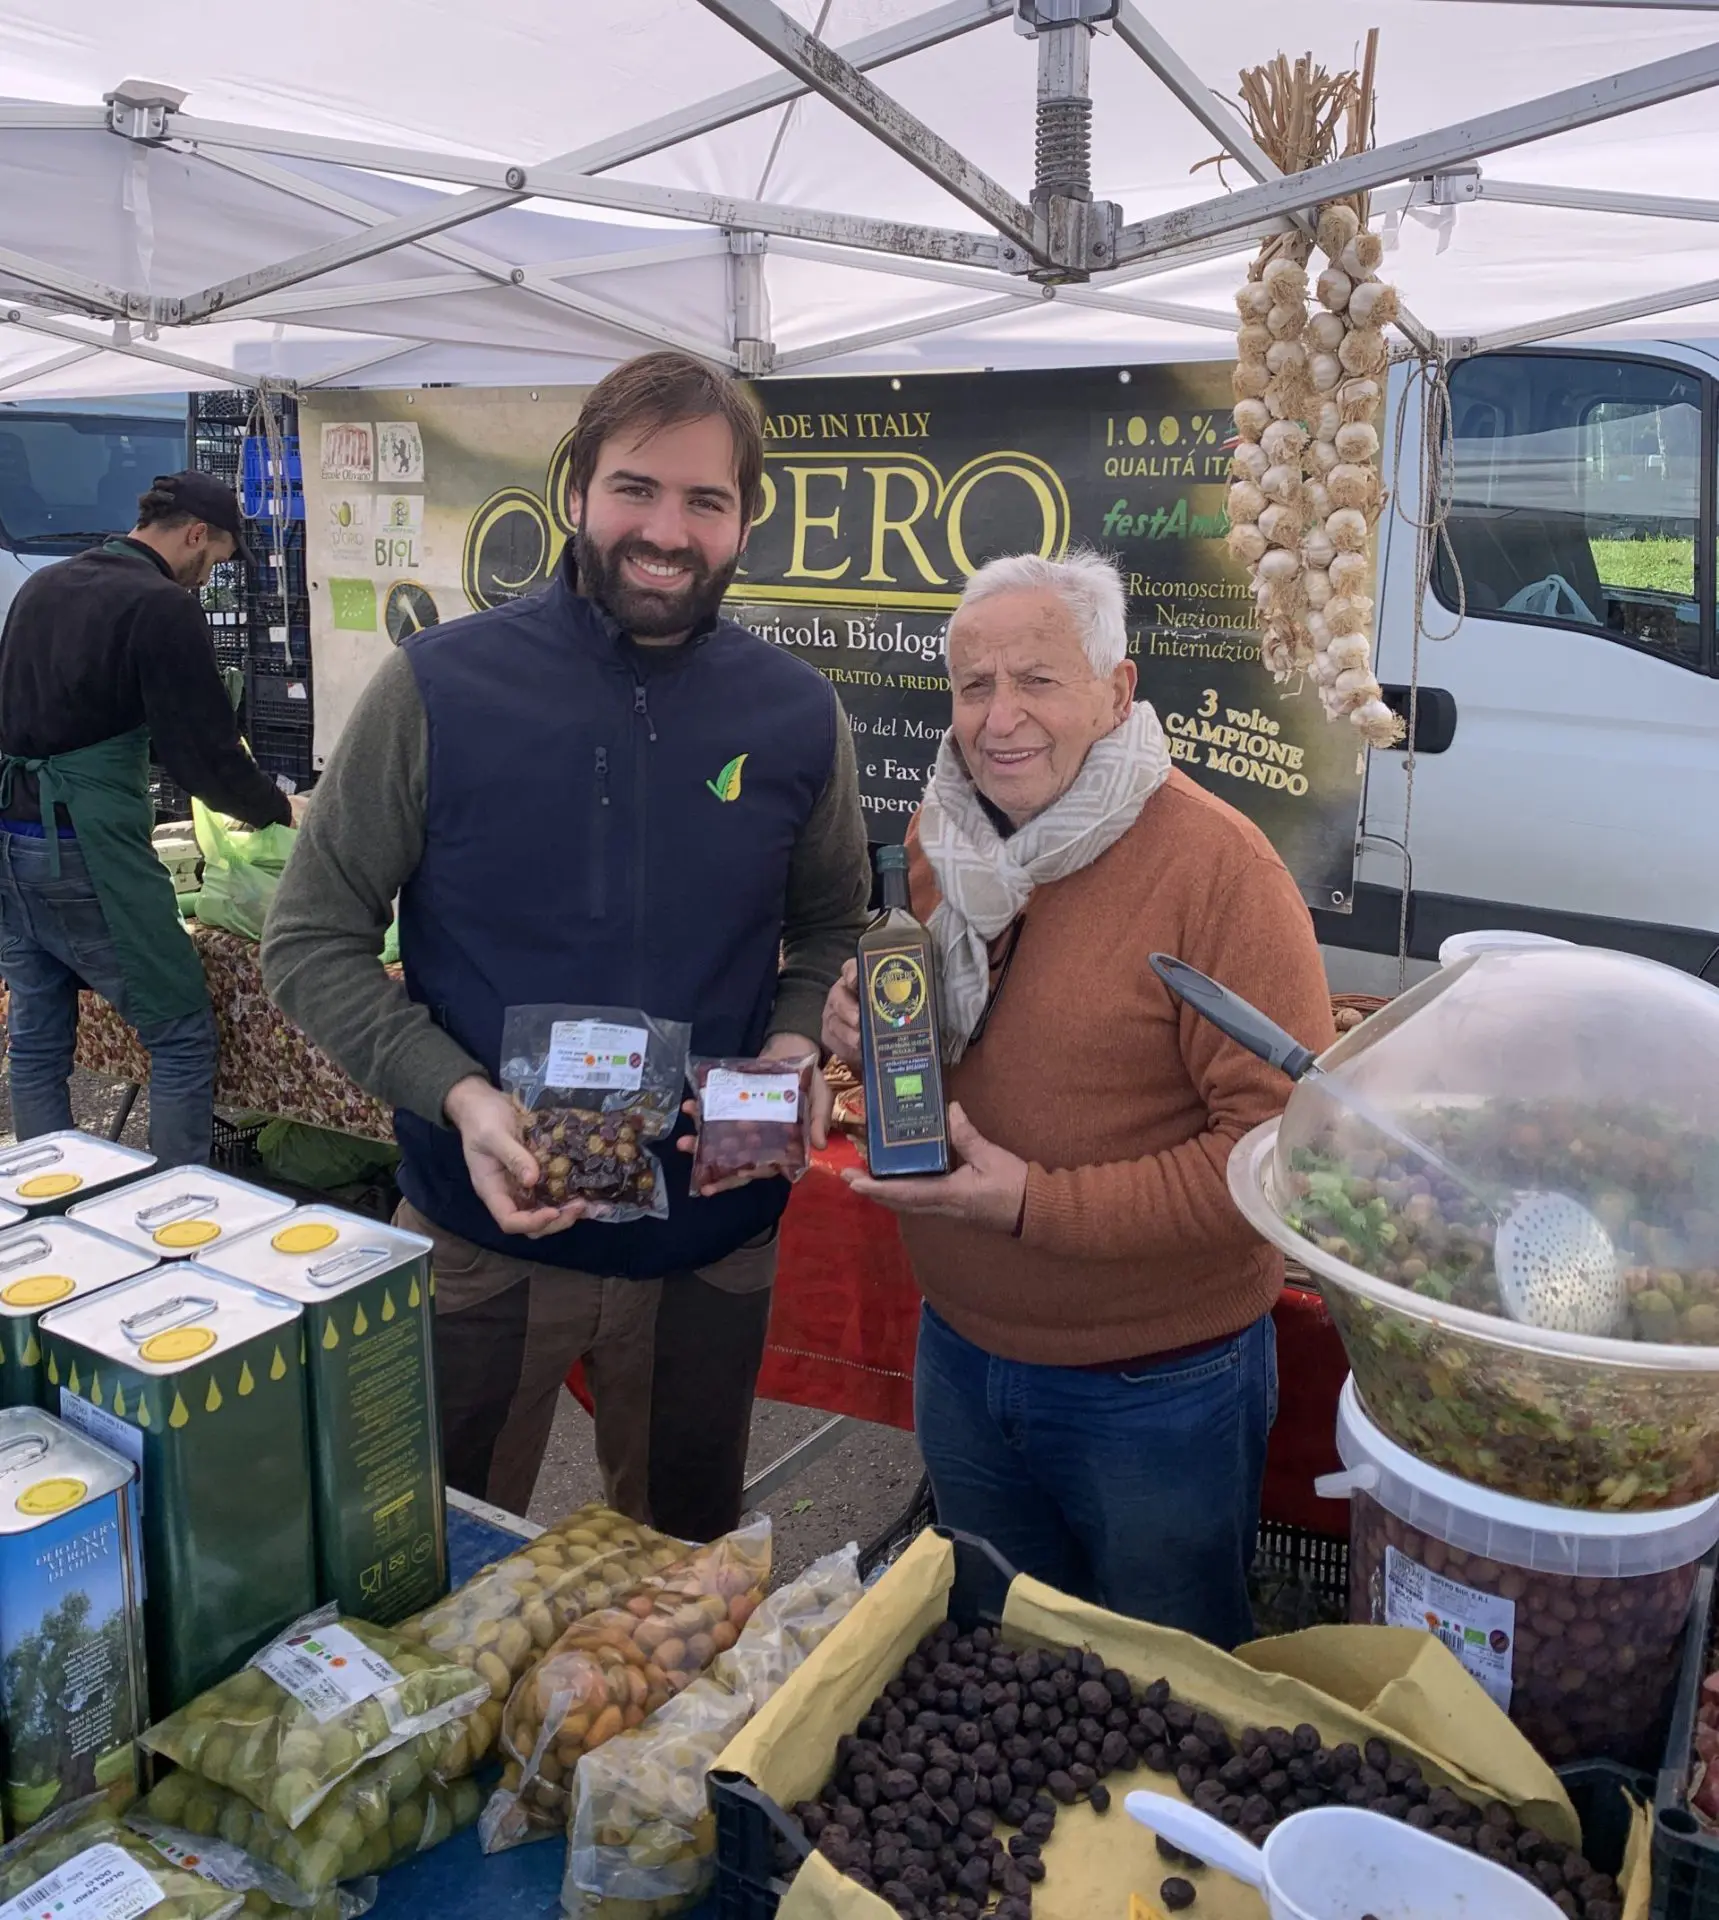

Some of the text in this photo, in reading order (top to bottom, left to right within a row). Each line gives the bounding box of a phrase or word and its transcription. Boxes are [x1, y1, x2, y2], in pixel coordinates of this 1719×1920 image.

[762, 411, 932, 440] ADE IN ITALY
[1103, 448, 1234, 478] QUALITÁ ITA
[374, 538, 420, 568] BIOL
[843, 618, 946, 662] Biologi
[817, 667, 952, 691] STRATTO A FREDD
[1197, 688, 1280, 737] 3 volte
[872, 717, 897, 737] del
[903, 719, 945, 740] Mon
[1165, 712, 1304, 771] CAMPIONE
[866, 763, 877, 777] e
[882, 758, 921, 781] Fax
[1205, 747, 1309, 797] MONDO
[858, 794, 921, 814] mpero
[84, 1868, 113, 1889] DOLCI
[99, 1870, 125, 1889] OLIVE
[72, 1884, 100, 1905] VERDI
